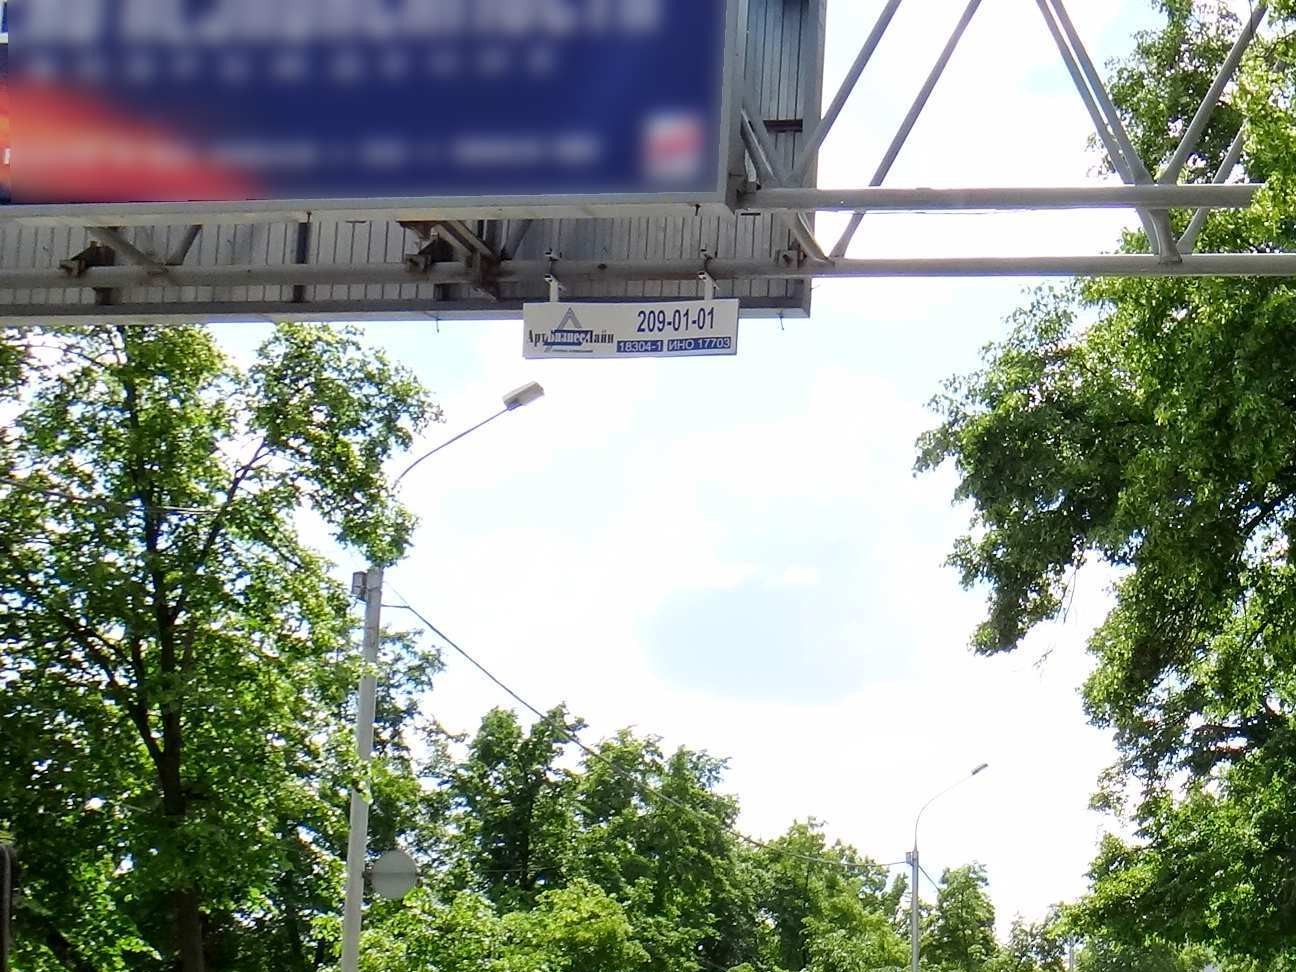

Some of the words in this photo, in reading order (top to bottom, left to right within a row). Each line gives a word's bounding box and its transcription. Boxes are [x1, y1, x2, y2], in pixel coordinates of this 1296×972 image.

[636, 307, 715, 333] 209-01-01
[619, 340, 662, 352] 18304-1
[668, 338, 695, 350] ИНО
[699, 336, 730, 348] 17703
